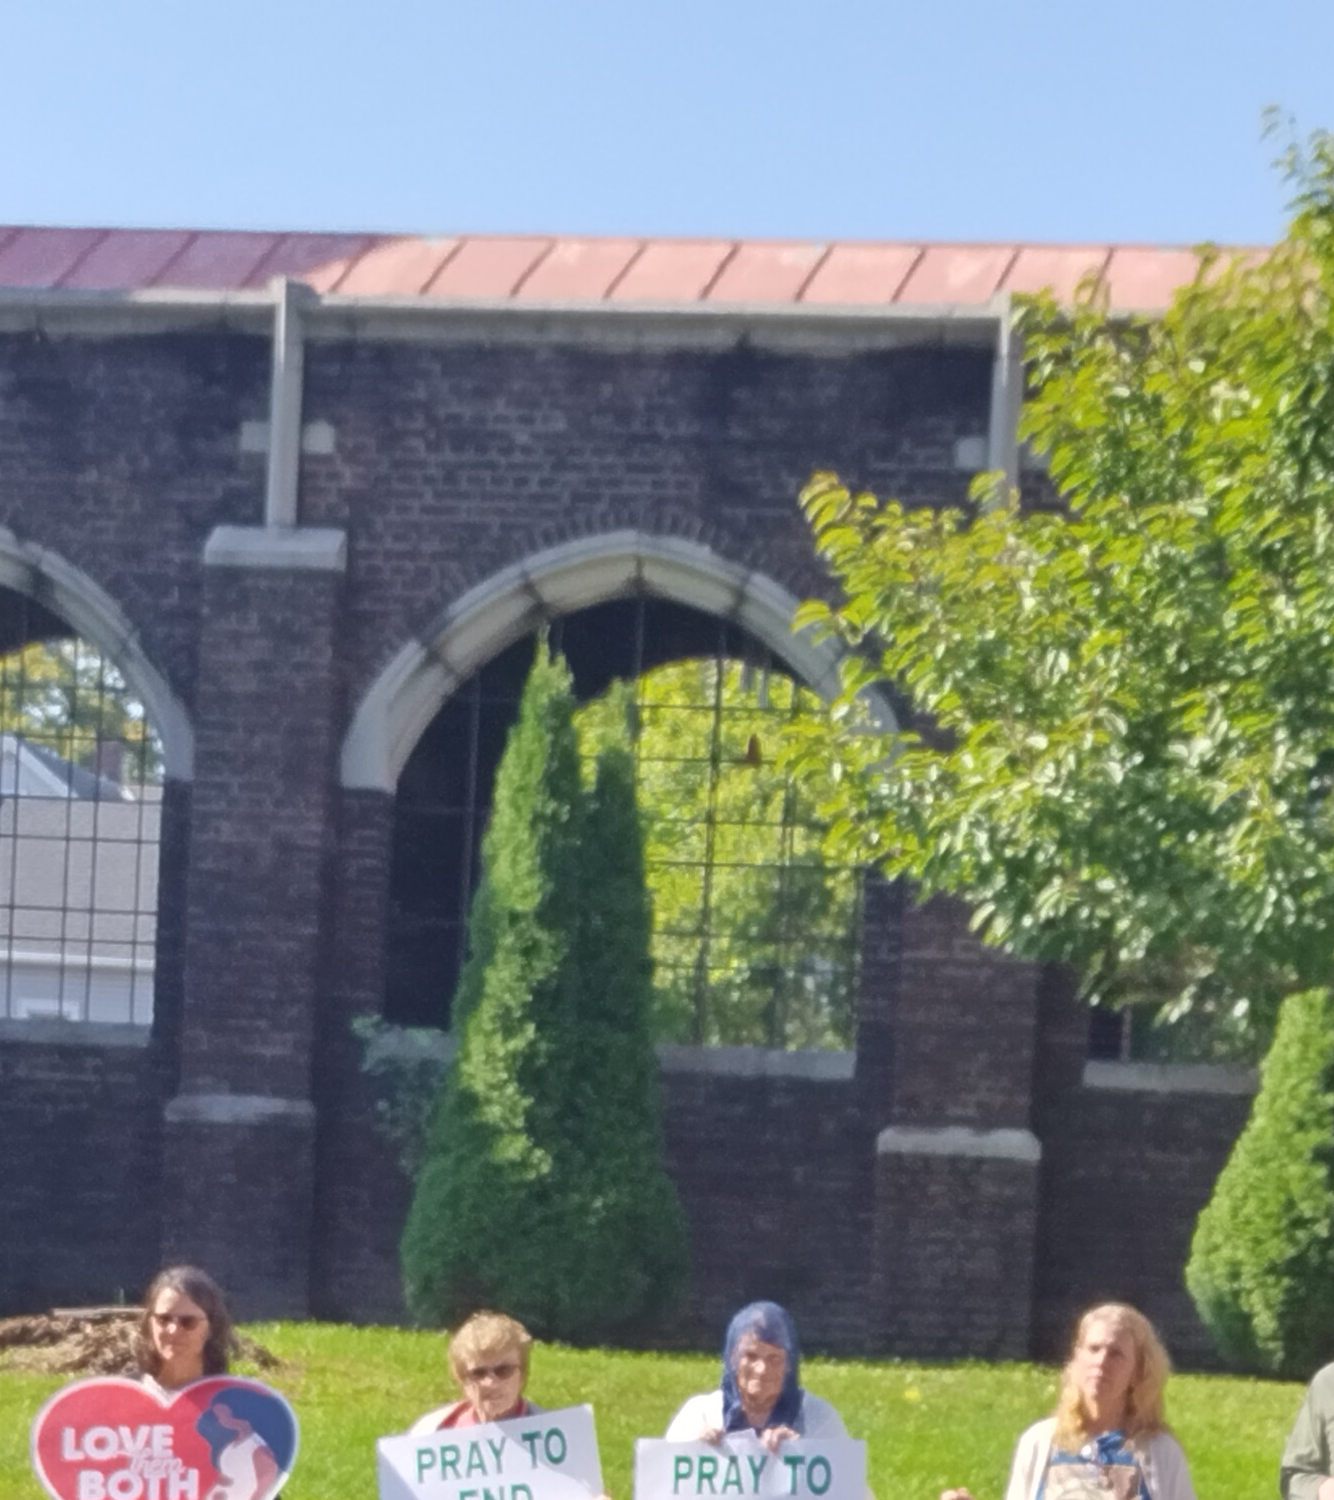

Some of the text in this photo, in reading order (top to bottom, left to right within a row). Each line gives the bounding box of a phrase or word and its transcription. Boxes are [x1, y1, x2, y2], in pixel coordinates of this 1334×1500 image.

[60, 1425, 174, 1461] LOVE
[416, 1427, 567, 1483] PRAY TO
[672, 1455, 831, 1496] PRAY TO
